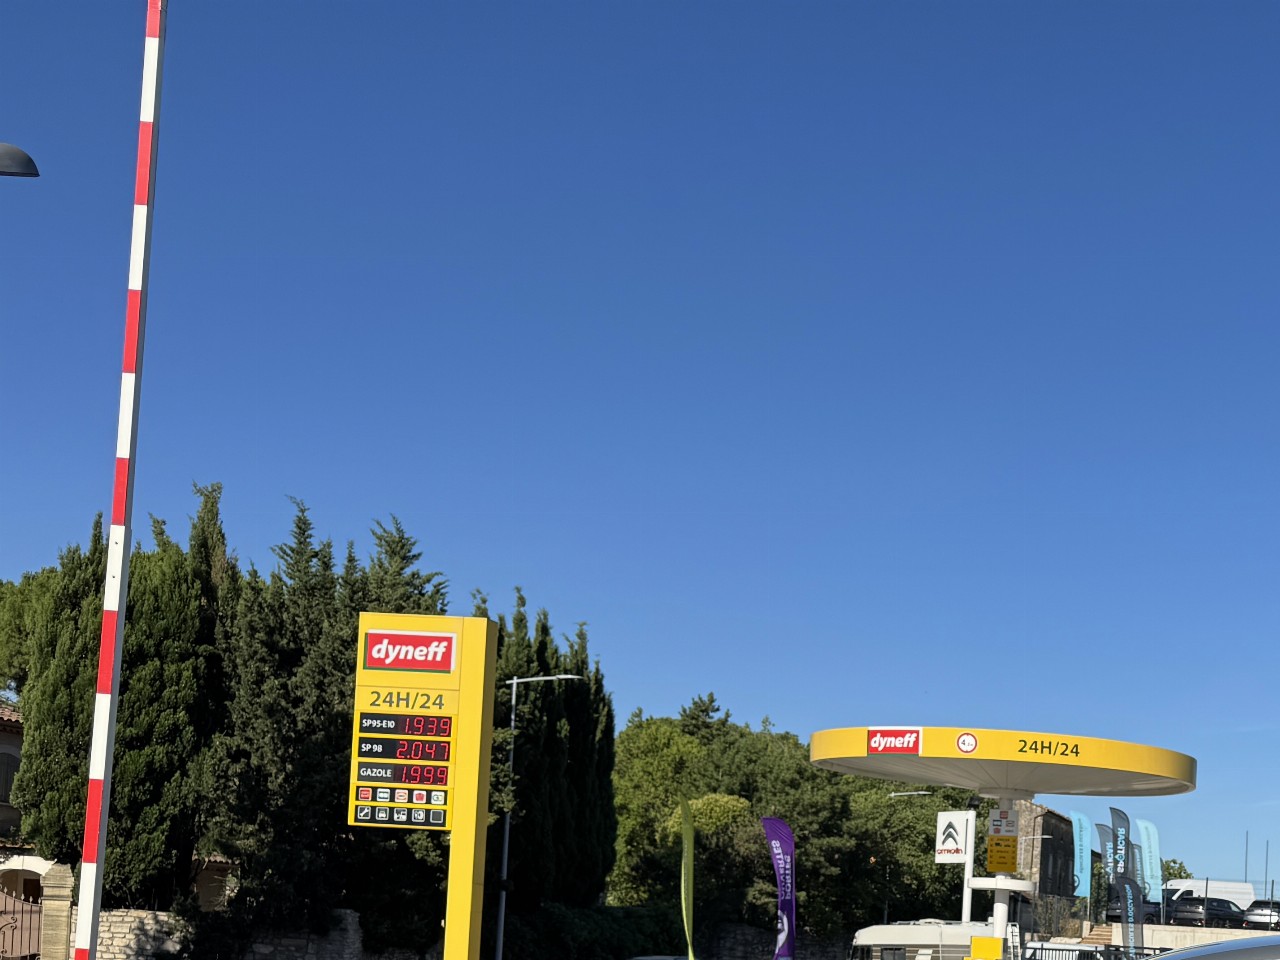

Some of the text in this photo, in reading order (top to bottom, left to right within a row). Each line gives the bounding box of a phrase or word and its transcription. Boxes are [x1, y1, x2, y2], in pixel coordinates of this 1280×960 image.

[371, 638, 449, 664] dyneff
[369, 691, 445, 710] 24H/24
[362, 717, 450, 736] SP95-E10 1.939
[361, 741, 449, 760] SP 98 2.047
[870, 732, 918, 750] dyneff
[1018, 739, 1080, 757] 24H/24
[360, 766, 447, 785] GAZOLE 1.999
